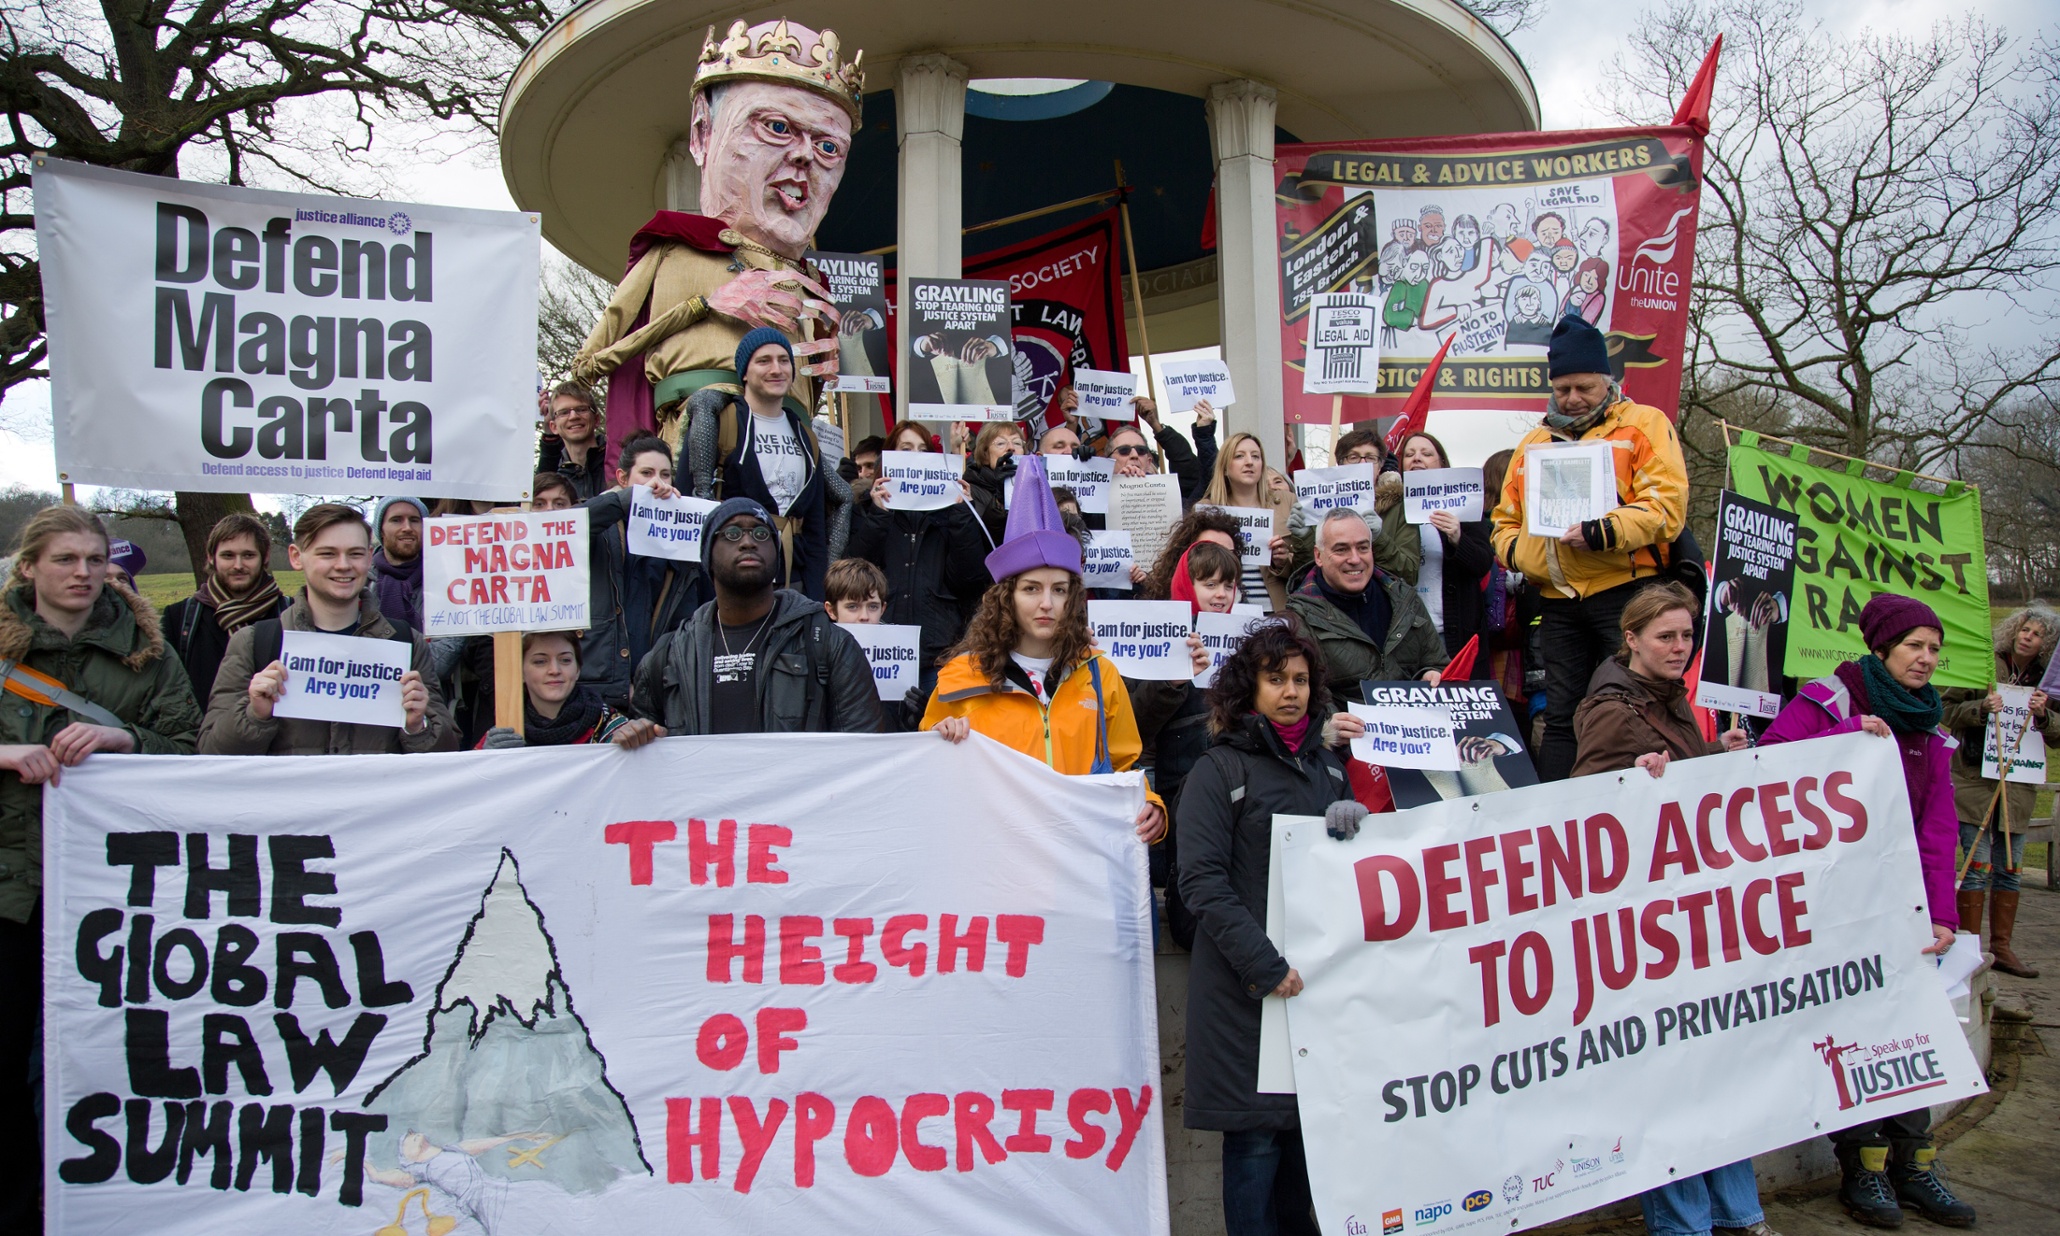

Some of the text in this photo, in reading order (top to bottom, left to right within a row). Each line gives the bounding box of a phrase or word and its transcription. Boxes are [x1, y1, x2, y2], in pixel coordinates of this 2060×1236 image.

[1332, 144, 1651, 184] LEGAL & ADVICE WORKERS
[1540, 194, 1600, 207] LEGAL AID
[1549, 185, 1581, 197] SAVE
[295, 208, 386, 229] justice alliance
[1286, 205, 1369, 277] London &
[155, 201, 433, 303] Defend
[1293, 231, 1359, 291] Eastern
[1009, 245, 1098, 293] SOCIETY
[1293, 250, 1359, 307] 785 Branch
[837, 285, 872, 296] SYSTEM
[859, 277, 879, 287] OUR
[1618, 265, 1679, 297] unite
[832, 294, 853, 304] PART
[914, 285, 1005, 304] GRAYLING
[1630, 296, 1677, 311] theUNION
[915, 301, 940, 311] STOP
[941, 301, 982, 312] TEARING
[984, 303, 1005, 313] OUR
[923, 310, 997, 322] JUSTICE SYSTEM
[944, 320, 976, 331] APART
[1460, 311, 1497, 334] NO TO
[154, 286, 433, 391] Magna
[1318, 328, 1370, 342] LEGAL AID
[1170, 371, 1229, 385] am for justice.
[1438, 367, 1541, 388] & RIGHTS
[1078, 382, 1135, 396] am for justice.
[1182, 384, 1217, 397] Are you?
[1085, 393, 1122, 407] Are you?
[200, 377, 433, 465] Carta
[755, 433, 800, 447] AVE UK
[755, 444, 802, 456] USTICE
[202, 462, 432, 482] Defend access to justice Defend legal aid
[889, 467, 904, 478] am
[906, 467, 923, 479] for
[1051, 470, 1110, 483] am for justice.
[899, 481, 946, 496] Are you?
[1078, 485, 1096, 497] you?
[1301, 480, 1373, 496] am for justice.
[1410, 482, 1482, 497] am for justice.
[1313, 493, 1360, 509] Are you?
[1421, 495, 1467, 510] Are you?
[1757, 465, 1944, 546] WOMEN
[638, 506, 672, 521] am for
[1254, 516, 1269, 528] aid
[430, 520, 576, 546] DEFEND THE
[648, 523, 700, 542] Are you?
[1724, 503, 1794, 546] GRAYLING
[111, 545, 130, 555] ance
[1100, 546, 1133, 560] justice.
[1723, 527, 1793, 560] STOP TEARING OUR
[464, 540, 575, 574] MAGNA
[1727, 543, 1785, 571] JUSTICE SYSTEM
[1795, 526, 1972, 595] GAINST
[1096, 561, 1120, 575] you?
[1742, 562, 1769, 580] APART
[447, 574, 551, 605] CARTA
[491, 607, 527, 625] GLOBAL
[530, 606, 548, 622] LAW
[551, 602, 585, 620] SUMMIT
[1805, 582, 1864, 634] RA
[1097, 621, 1191, 640] am for justice.
[1111, 641, 1171, 660] Are you?
[1202, 635, 1220, 648] am
[872, 645, 917, 662] justice.
[289, 656, 315, 673] am
[318, 657, 345, 675] for
[305, 676, 380, 700] Are you?
[1371, 686, 1498, 703] GRAYLING
[1471, 702, 1501, 710] OUR
[1379, 721, 1400, 735] for
[1401, 724, 1450, 739] justice.
[1372, 737, 1431, 755] Are you?
[604, 817, 793, 888] THE
[1353, 770, 1868, 942] DEFEND ACCESS
[106, 830, 342, 928] THE
[706, 912, 1045, 985] HEIGHT
[1468, 871, 1812, 1028] TO JUSTICE
[695, 1007, 807, 1075] OF
[1382, 954, 1884, 1123] STOP CUTS AND PRIVATISATION
[1871, 1032, 1930, 1058] Speak up for
[125, 1007, 388, 1099] LAW
[1850, 1049, 1945, 1106] JUSTICE
[665, 1083, 1153, 1195] HYPOCRISY
[58, 1092, 388, 1208] SUMMIT
[1572, 1157, 1600, 1173] UNISON
[1532, 1172, 1555, 1193] TUC
[1465, 1192, 1491, 1212] pcs
[1384, 1214, 1401, 1225] GMB
[1415, 1203, 1452, 1221] napo
[1347, 1221, 1367, 1236] fda
